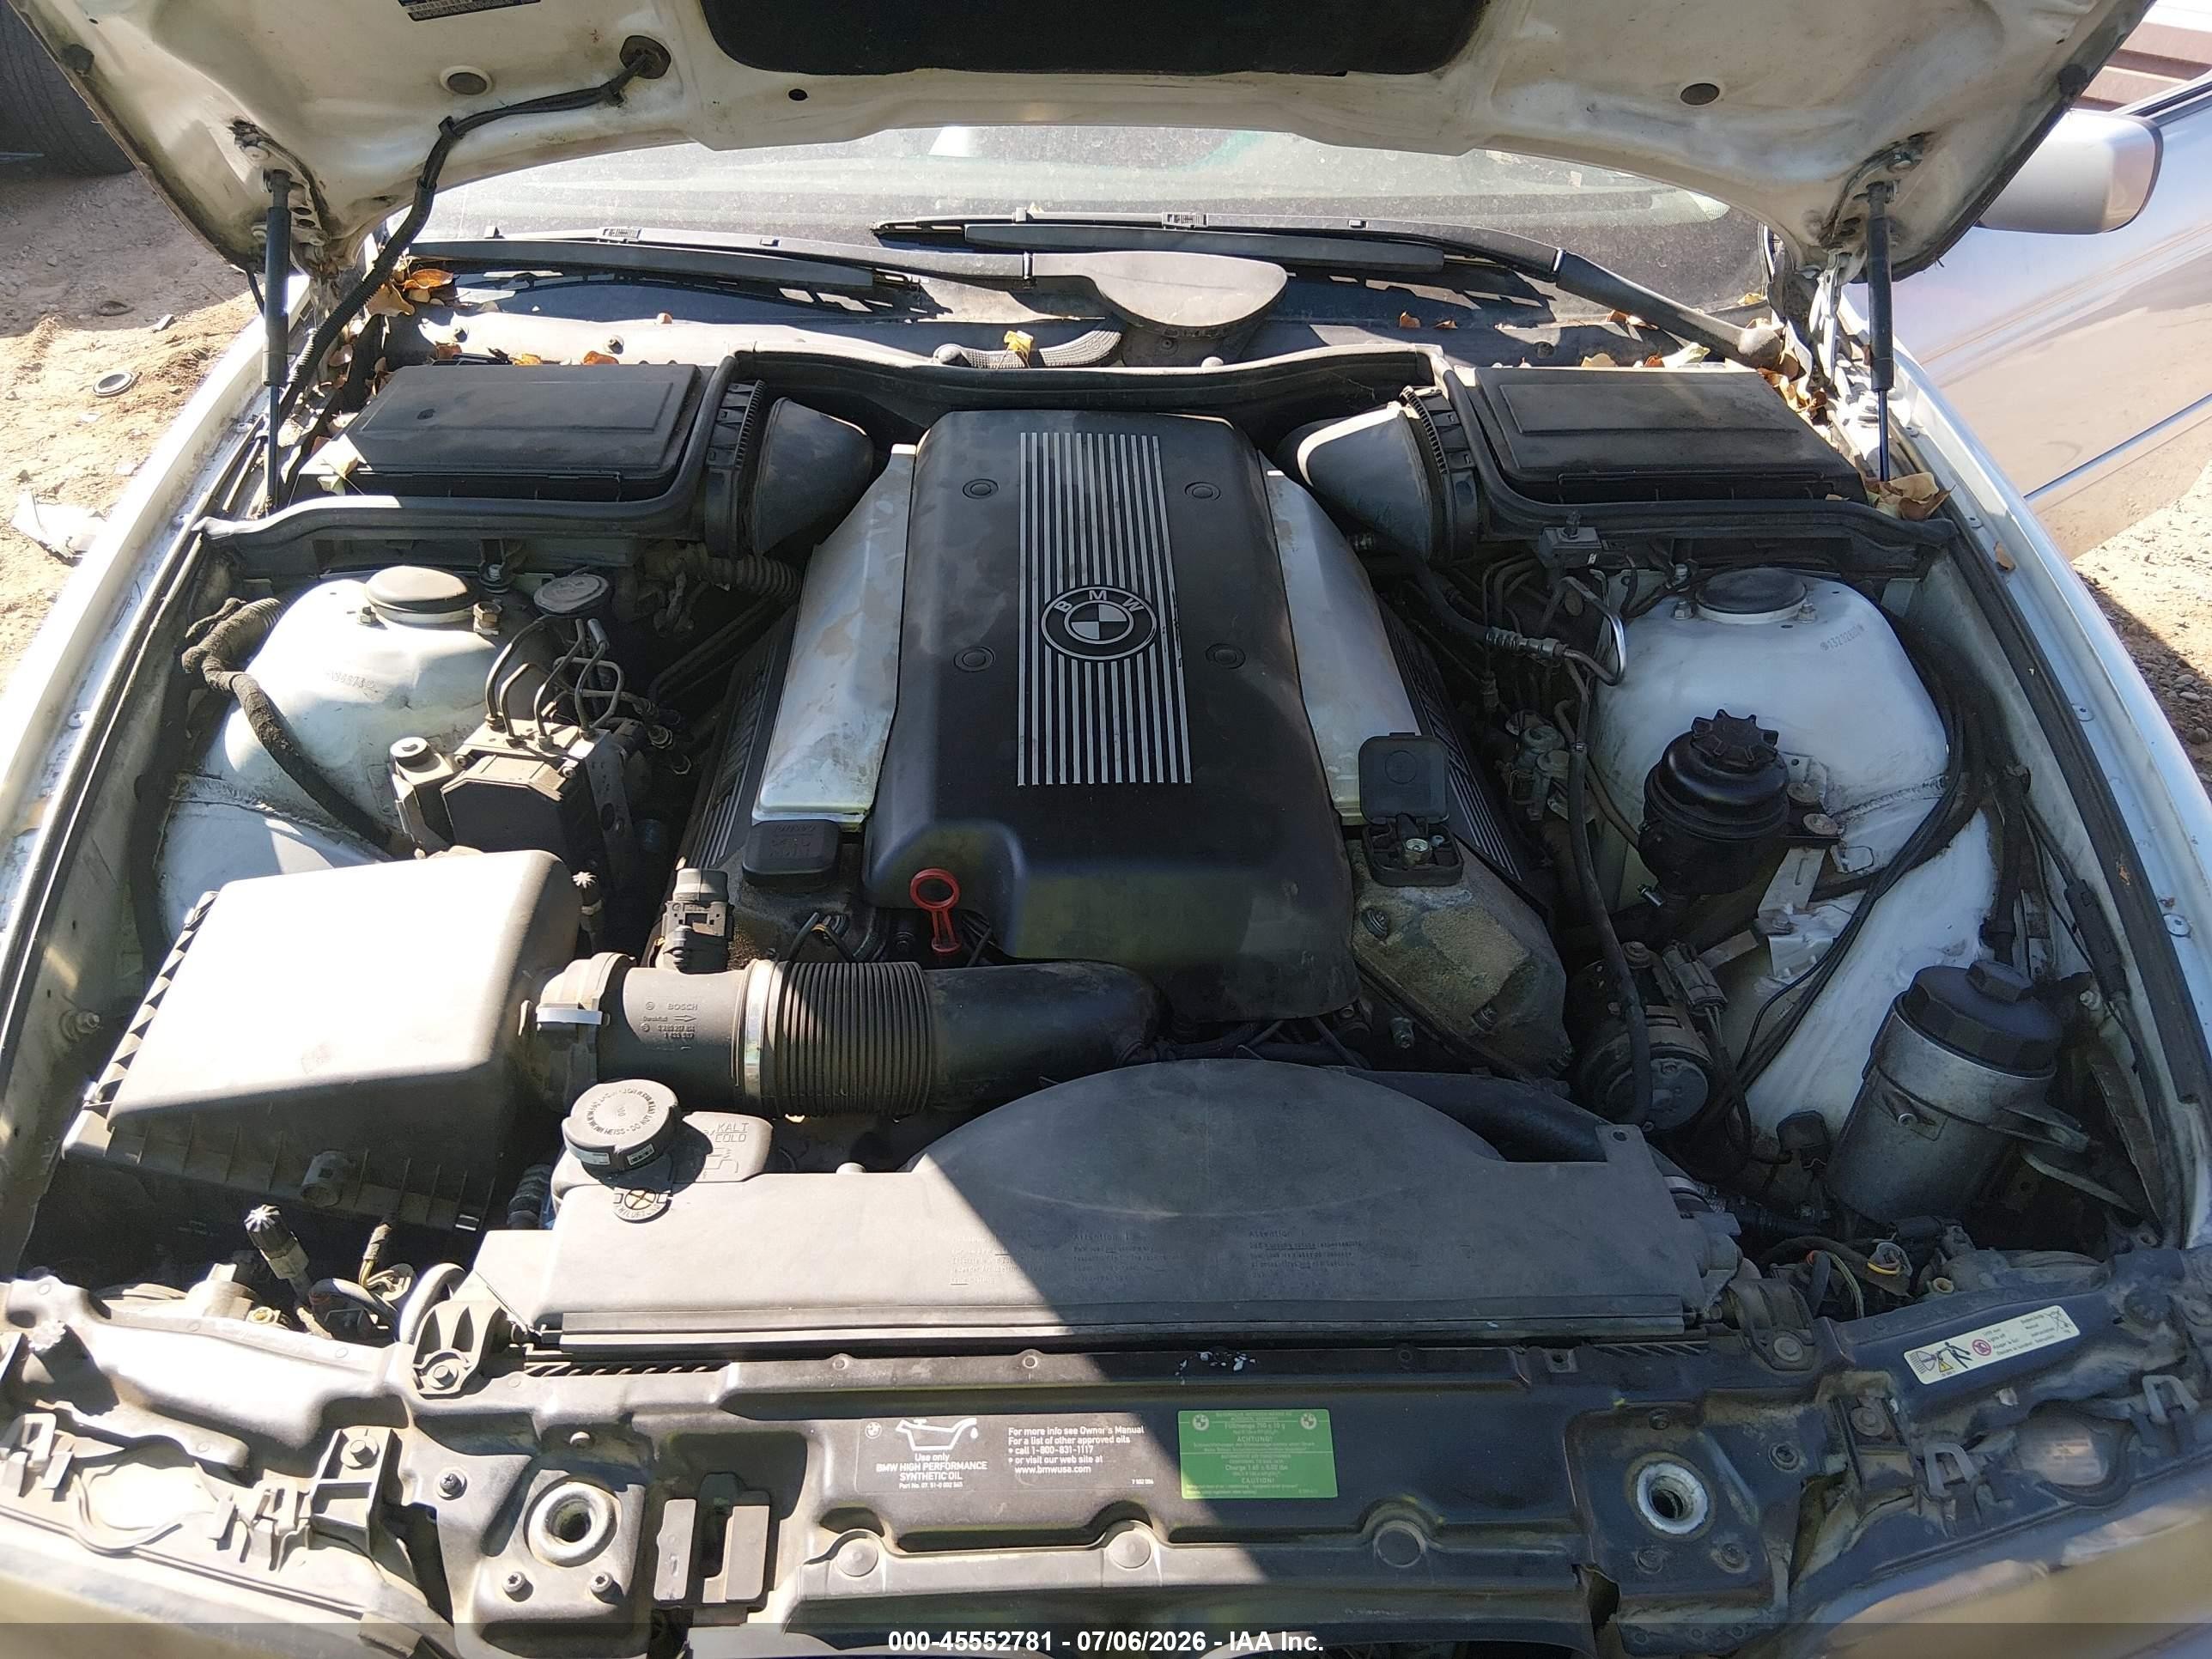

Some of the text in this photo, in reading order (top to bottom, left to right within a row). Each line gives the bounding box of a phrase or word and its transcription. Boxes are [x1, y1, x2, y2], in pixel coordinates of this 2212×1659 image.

[1054, 590, 1145, 613] BMW
[716, 1122, 750, 1133] KALT
[714, 1133, 748, 1143] COLD
[1008, 1427, 1022, 1436] For
[1047, 1426, 1062, 1435] info
[1079, 1425, 1113, 1435] Owner's
[1115, 1425, 1145, 1434] Manual
[1008, 1437, 1022, 1446] For
[1030, 1436, 1043, 1445] list
[1044, 1436, 1054, 1445] of
[1054, 1436, 1077, 1445] other
[1078, 1435, 1115, 1446] approved
[1115, 1434, 1131, 1443] oils
[1015, 1445, 1094, 1455] call 1-800-831-1117
[915, 1452, 950, 1463] Use only
[1025, 1455, 1042, 1464] visit
[1043, 1455, 1059, 1464] our
[1060, 1455, 1077, 1464] web
[1078, 1455, 1093, 1464] site
[1095, 1455, 1103, 1463] at
[876, 1461, 988, 1473] BMW HIGH PERFORMANCE
[1015, 1464, 1092, 1474] www.bmwusa.com
[899, 1470, 963, 1482] SYNTHETIC OIL
